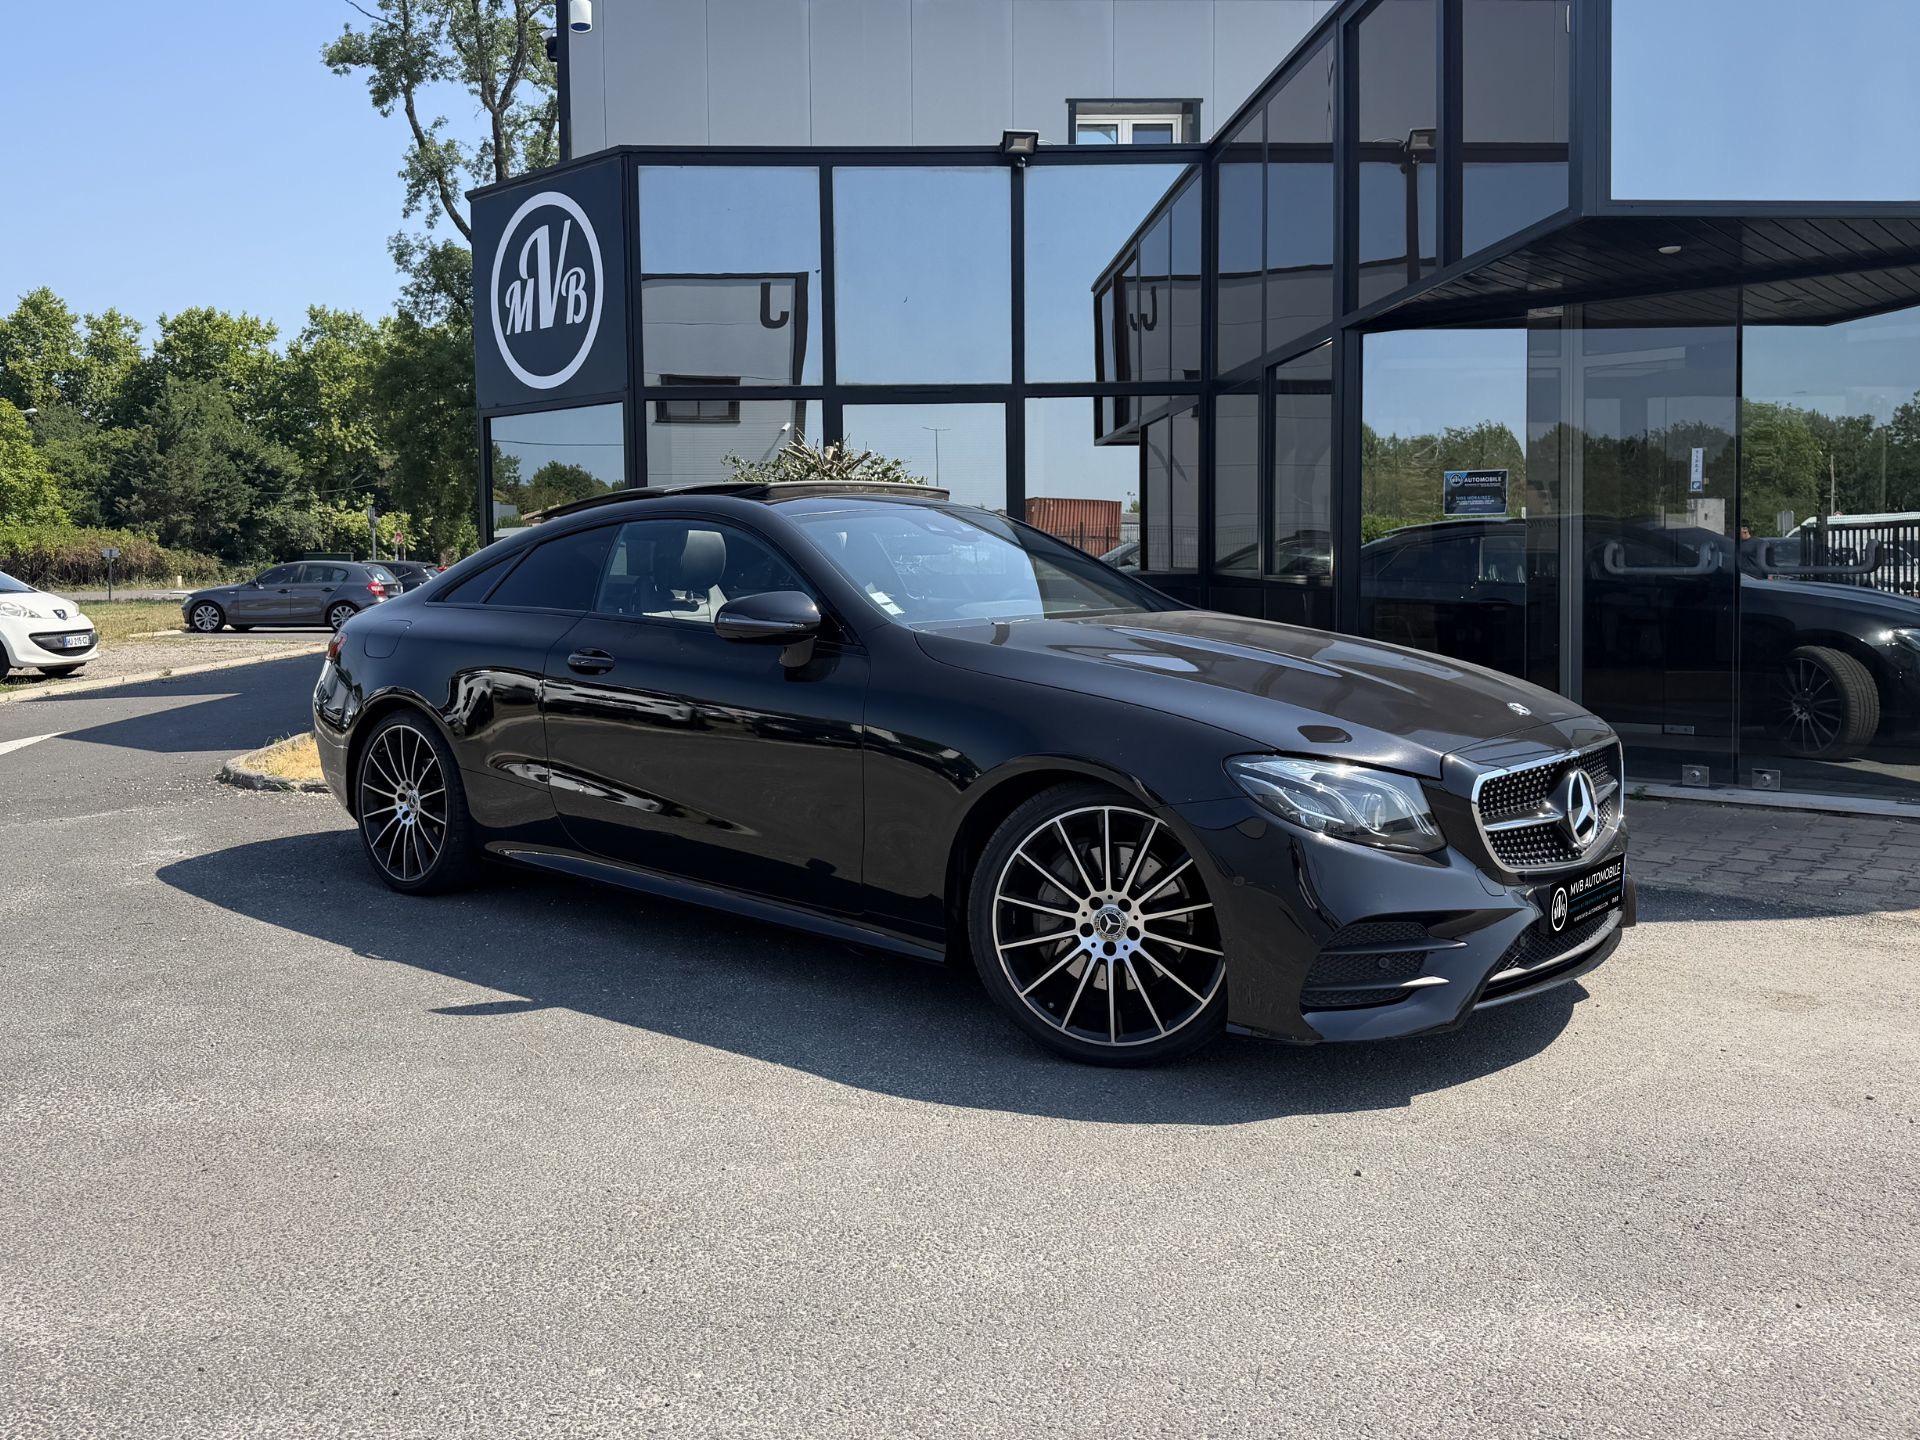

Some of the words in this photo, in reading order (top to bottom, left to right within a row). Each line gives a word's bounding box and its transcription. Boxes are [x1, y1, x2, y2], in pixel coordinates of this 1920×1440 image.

[505, 219, 588, 335] MVB
[1570, 880, 1584, 896] MVB
[1584, 862, 1621, 890] AUTOMOBILE
